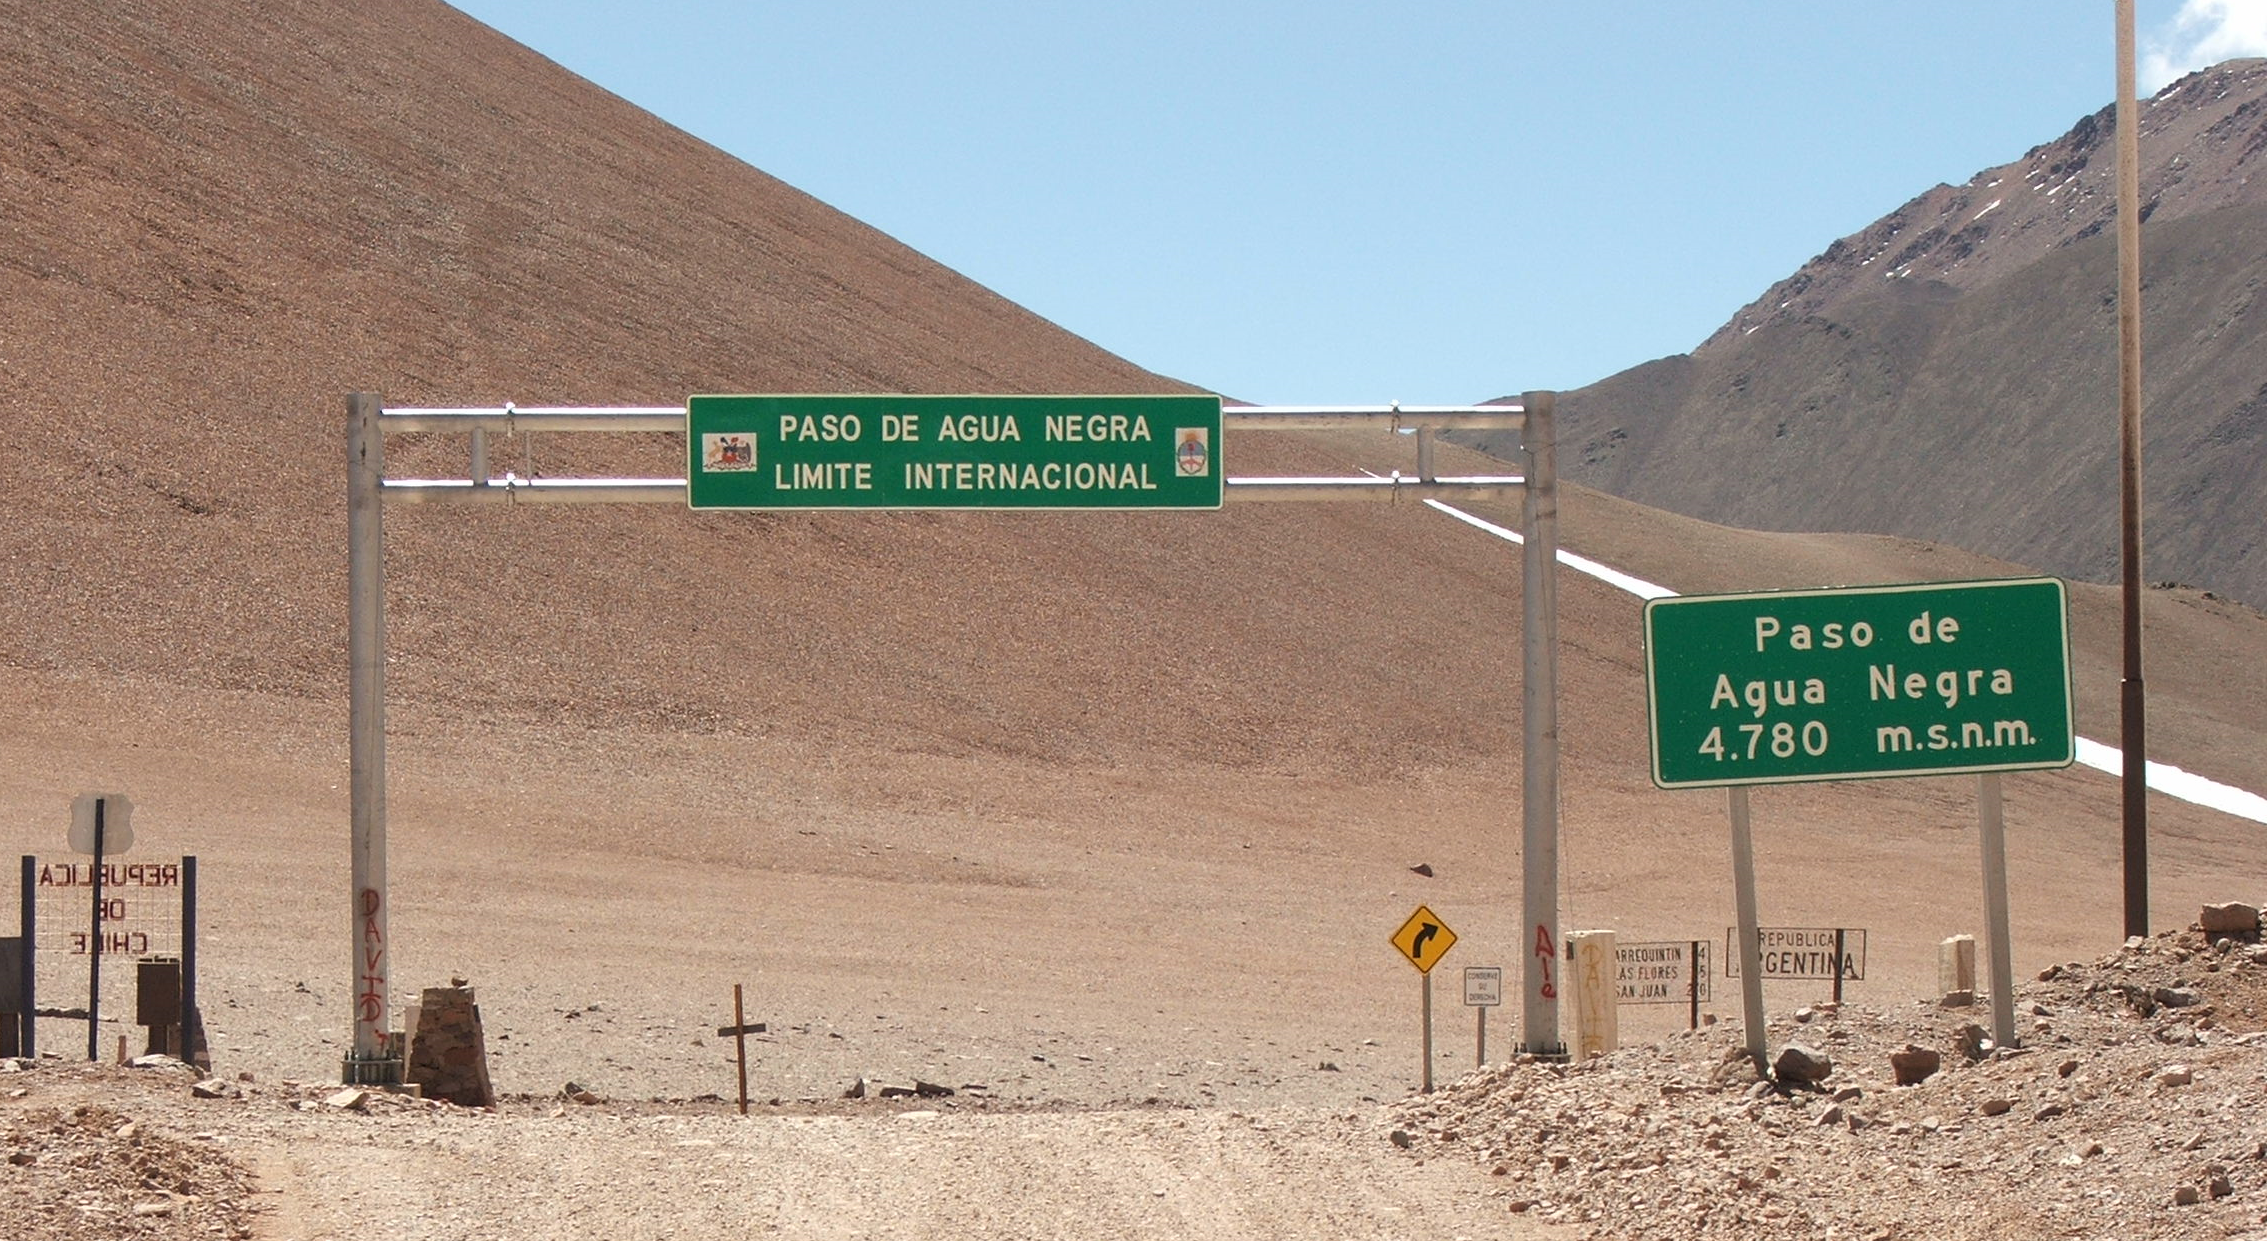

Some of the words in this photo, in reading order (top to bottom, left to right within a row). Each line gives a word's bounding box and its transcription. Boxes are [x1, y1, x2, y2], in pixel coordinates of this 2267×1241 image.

[779, 414, 862, 442] PASO
[881, 414, 920, 442] DE
[937, 414, 1022, 442] AGUA
[1045, 414, 1152, 442] NEGRA
[775, 462, 873, 490] LIMITE
[904, 462, 1158, 490] INTERNACIONAL
[1755, 616, 1874, 652] Paso
[1908, 610, 1960, 645] de
[1710, 673, 1826, 719] Agua
[1869, 663, 2013, 709] Negra
[1698, 720, 1828, 761] 4.780
[1876, 719, 2037, 753] m.s.n.m.
[1758, 932, 1835, 947] REPUBLICA
[360, 887, 384, 1023] DAVID
[1535, 924, 1557, 998] Ale
[1736, 951, 1856, 975] GENTINA
[1638, 965, 1678, 980] FLORES
[1639, 984, 1668, 998] JUAN
[1685, 983, 1707, 997] 20
